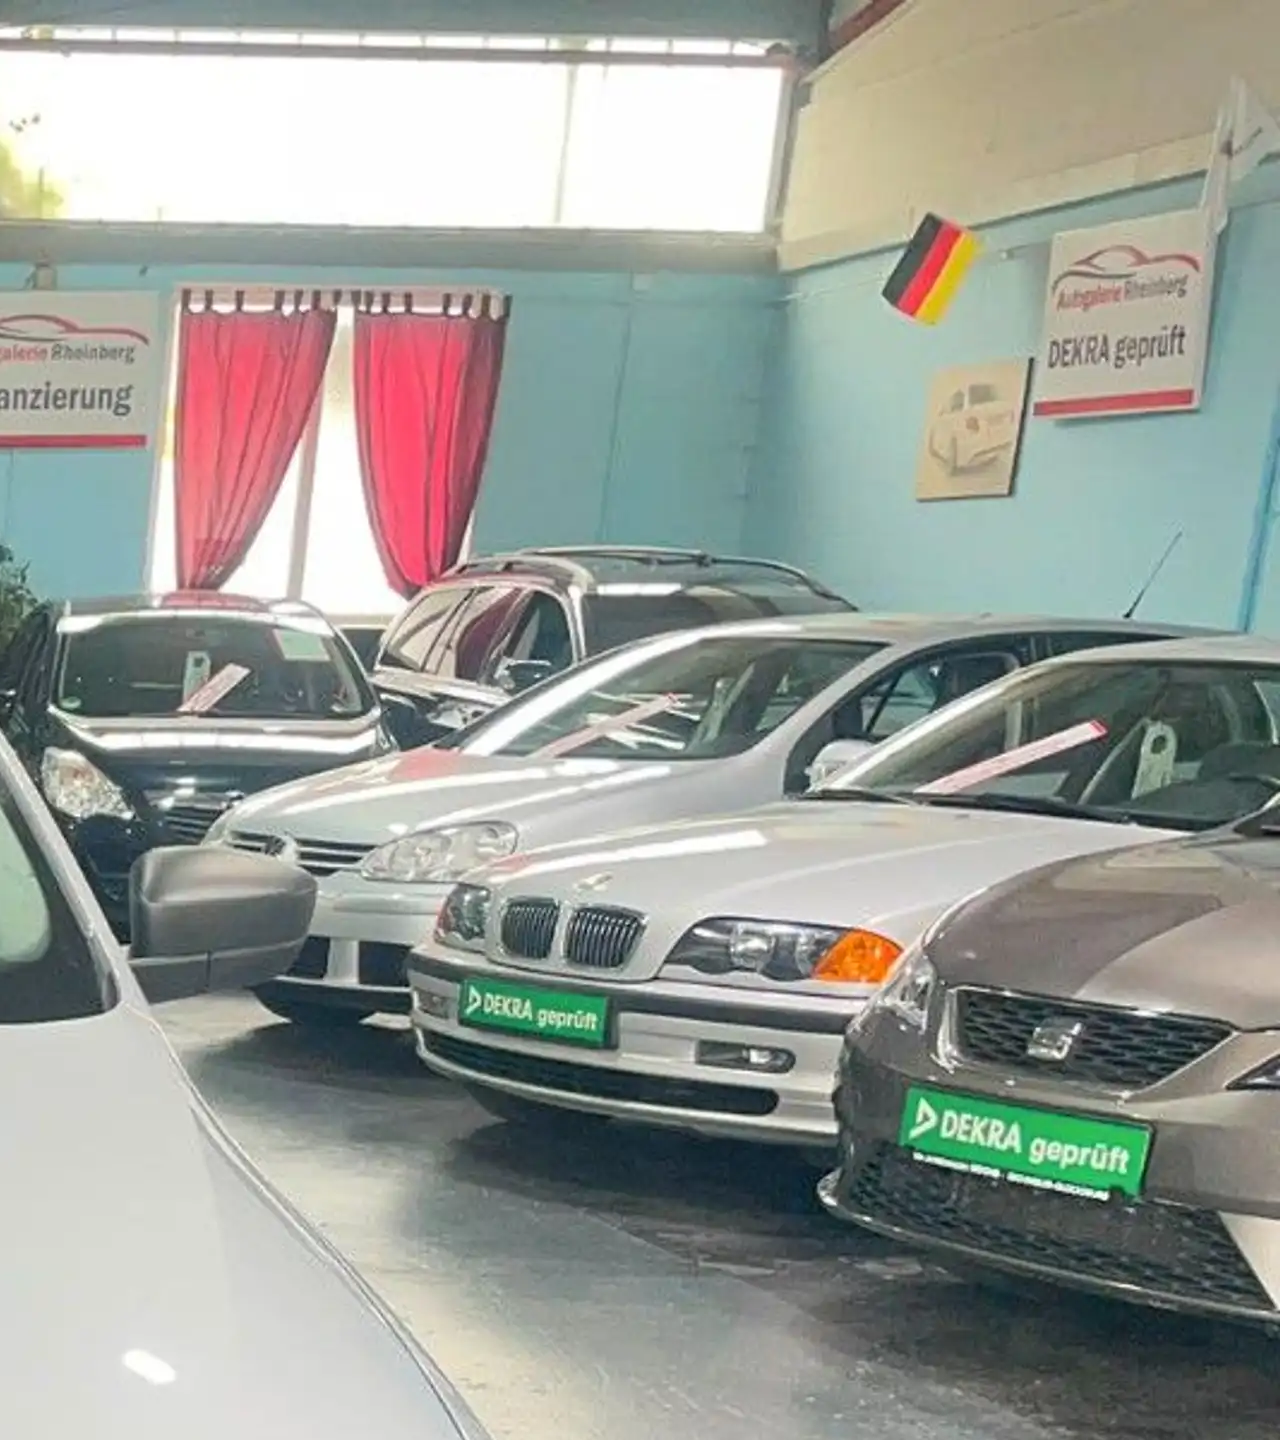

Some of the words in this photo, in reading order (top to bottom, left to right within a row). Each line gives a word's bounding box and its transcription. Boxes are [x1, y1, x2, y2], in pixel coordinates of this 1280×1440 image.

[50, 343, 136, 364] Rheinberg
[1047, 334, 1110, 369] DEKRA
[1113, 323, 1187, 370] geprüft
[482, 992, 533, 1021] DEKRA
[537, 1008, 598, 1031] geprüft
[938, 1109, 1023, 1154] DEKRA
[1028, 1135, 1130, 1175] geprüft
